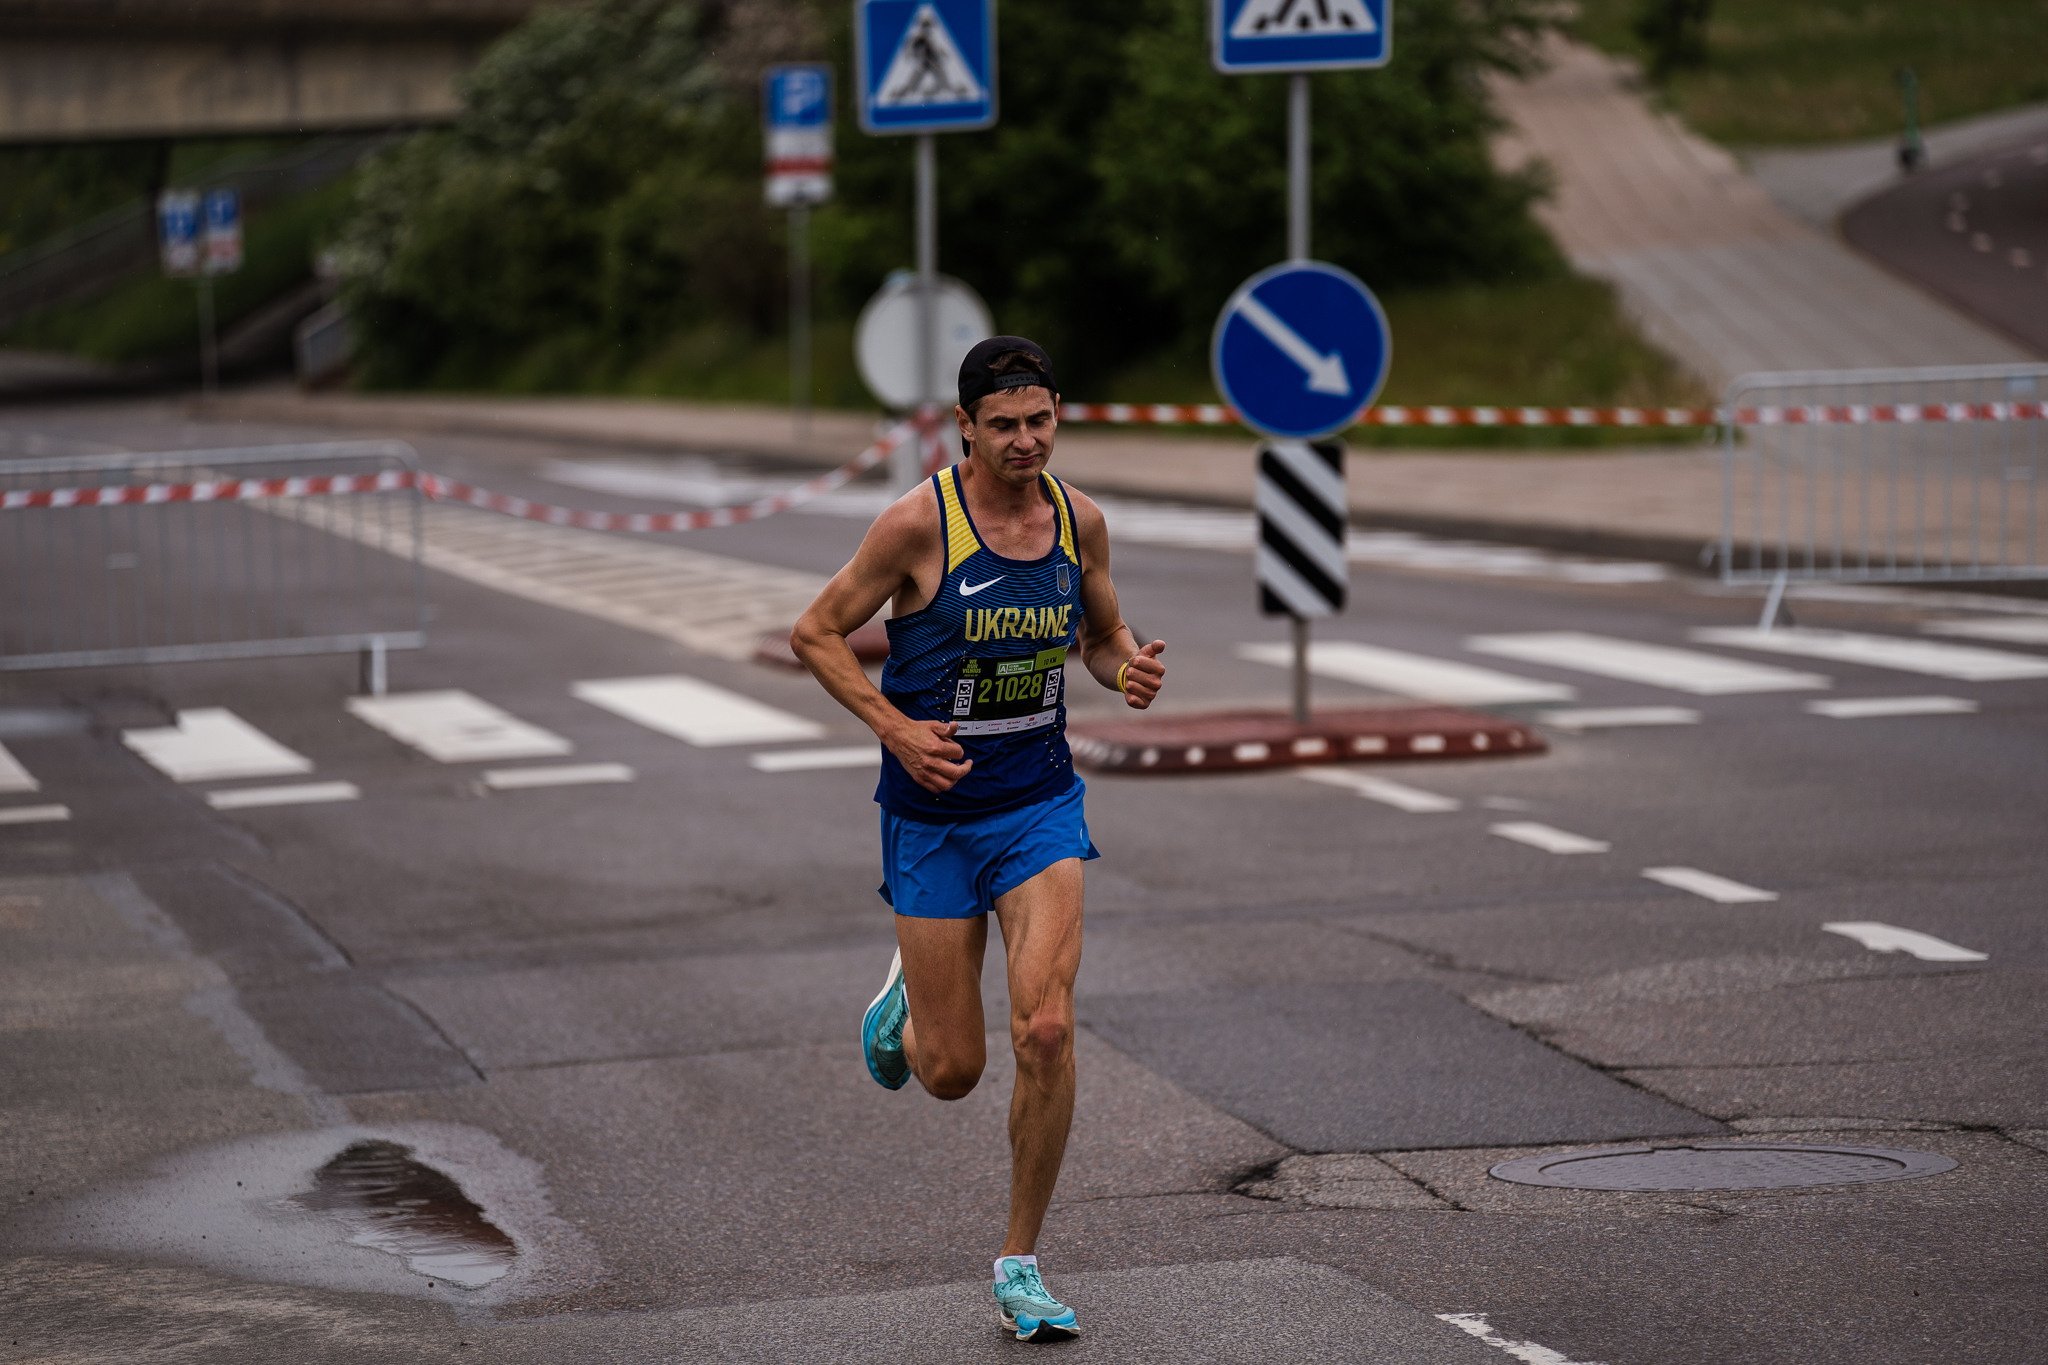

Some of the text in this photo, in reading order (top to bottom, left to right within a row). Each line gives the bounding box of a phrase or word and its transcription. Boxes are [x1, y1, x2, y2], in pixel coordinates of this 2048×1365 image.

[783, 70, 823, 115] P
[965, 604, 1072, 642] UKRAINE
[999, 665, 1006, 673] A
[977, 674, 1043, 703] 21028
